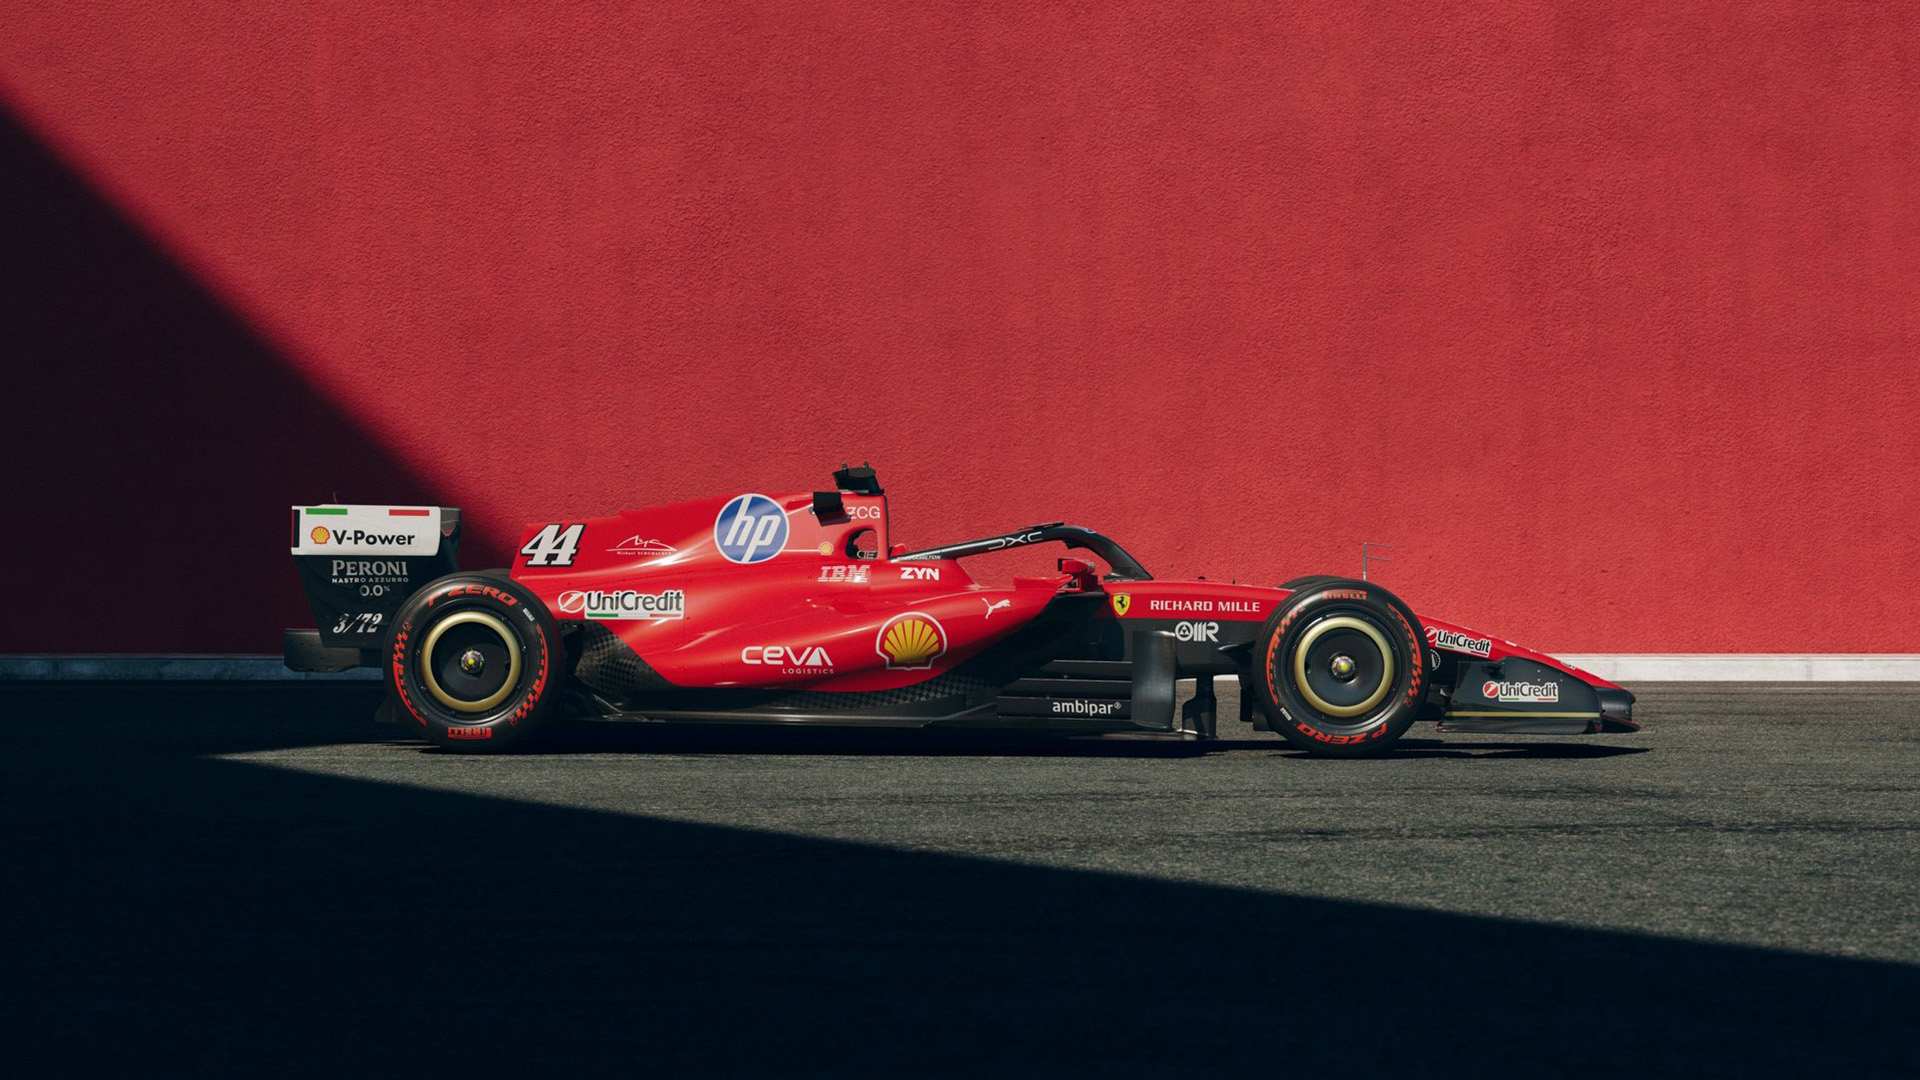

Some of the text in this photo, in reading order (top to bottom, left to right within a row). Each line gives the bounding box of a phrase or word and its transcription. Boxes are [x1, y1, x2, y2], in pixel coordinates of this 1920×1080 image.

[332, 529, 415, 545] V-Power
[723, 494, 781, 562] hp
[520, 522, 586, 567] 44
[331, 560, 408, 576] PERONI
[817, 565, 870, 583] IBM
[900, 567, 940, 580] ZYN
[586, 590, 683, 612] UniCredit
[1150, 599, 1260, 612] RICHARD MILLE
[332, 612, 383, 634] 3/72
[1437, 630, 1491, 653] UniCredit
[1500, 682, 1558, 697] UniCredit
[1297, 722, 1388, 744] P ZERO
